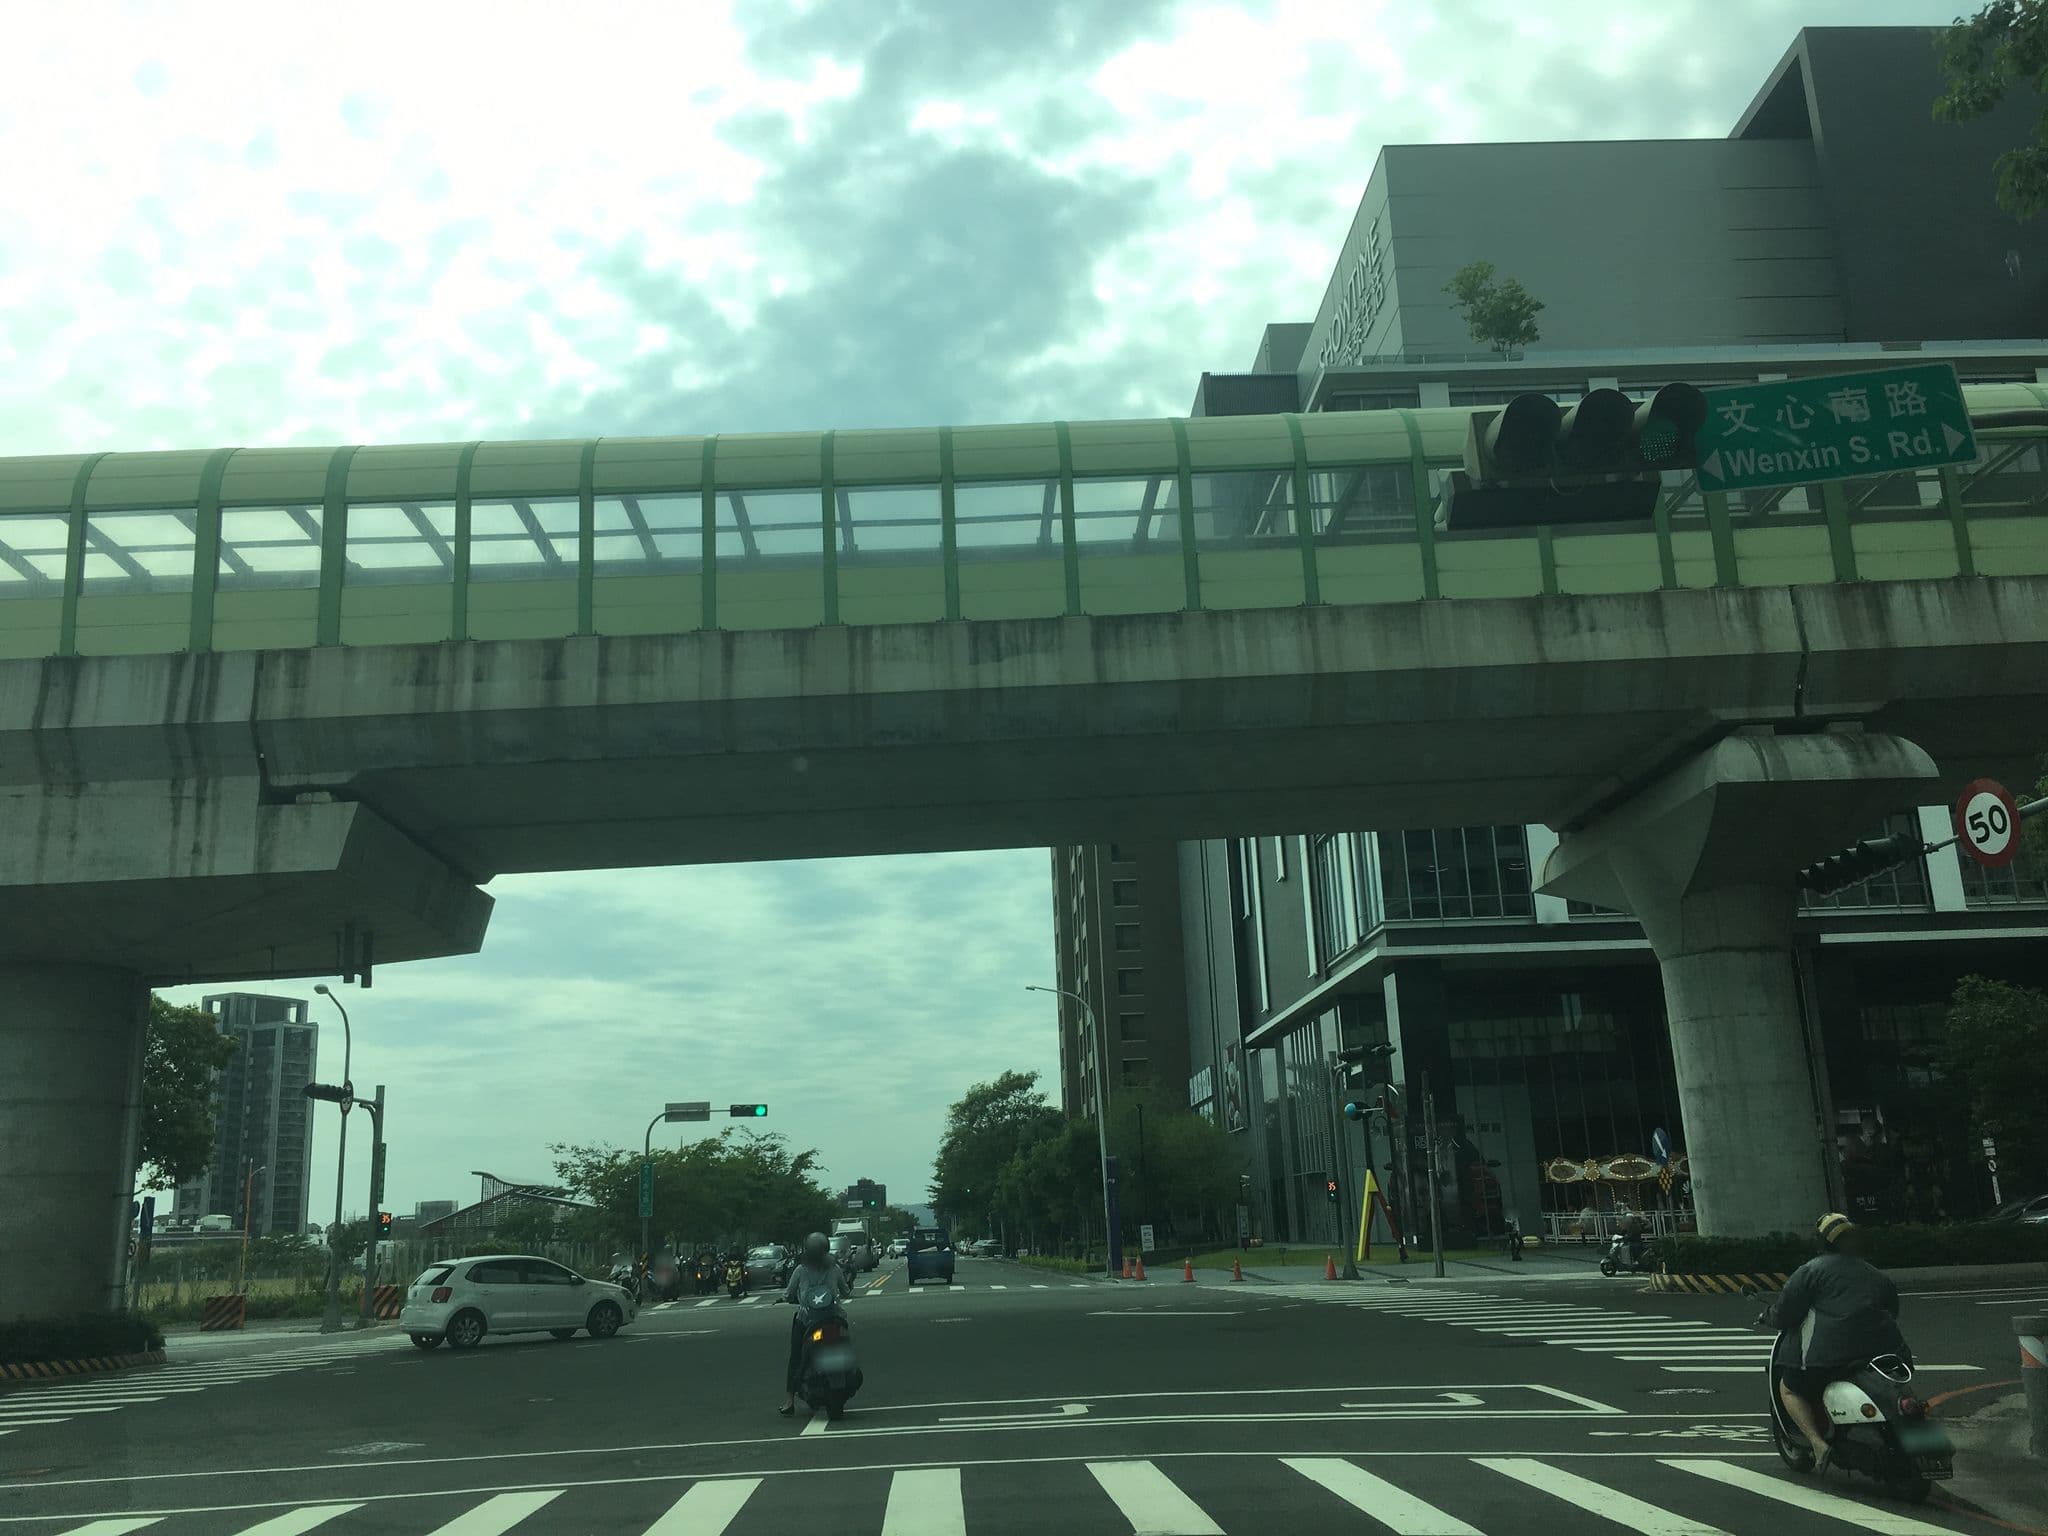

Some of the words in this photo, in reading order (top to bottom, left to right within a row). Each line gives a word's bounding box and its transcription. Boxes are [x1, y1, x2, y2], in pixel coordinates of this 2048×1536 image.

[1716, 381, 1928, 437] 文心南路
[1724, 442, 1841, 477] Wenxin
[1848, 436, 1881, 464] S.
[1888, 427, 1942, 458] Rd.
[1968, 805, 2008, 844] 50
